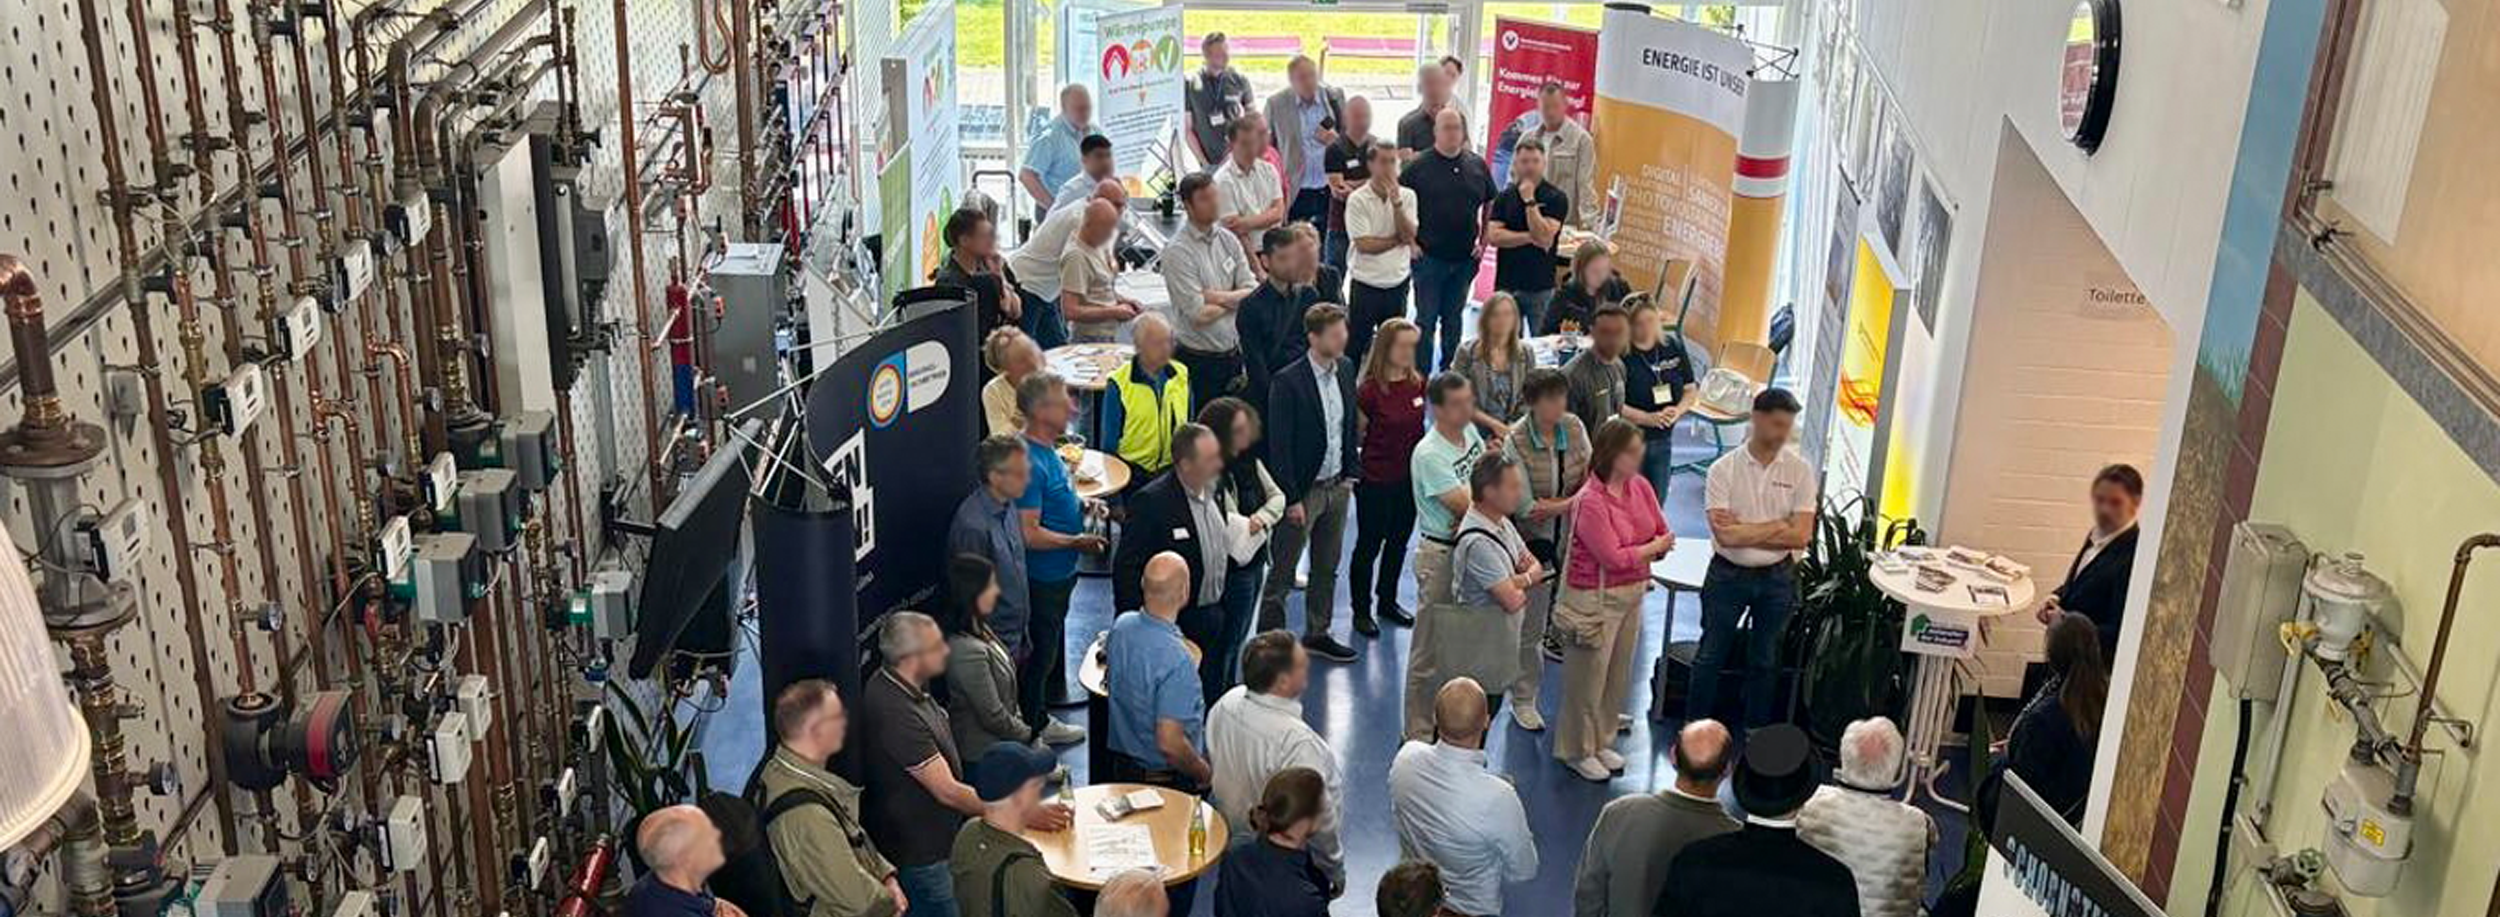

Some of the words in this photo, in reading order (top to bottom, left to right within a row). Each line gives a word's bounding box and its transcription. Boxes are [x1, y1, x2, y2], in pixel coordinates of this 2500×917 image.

[1499, 67, 1543, 84] Kommen
[1643, 48, 1700, 77] ENERGIE
[1702, 63, 1719, 82] IST
[2088, 288, 2147, 305] Toilette
[2003, 835, 2110, 917] SCHORNST
